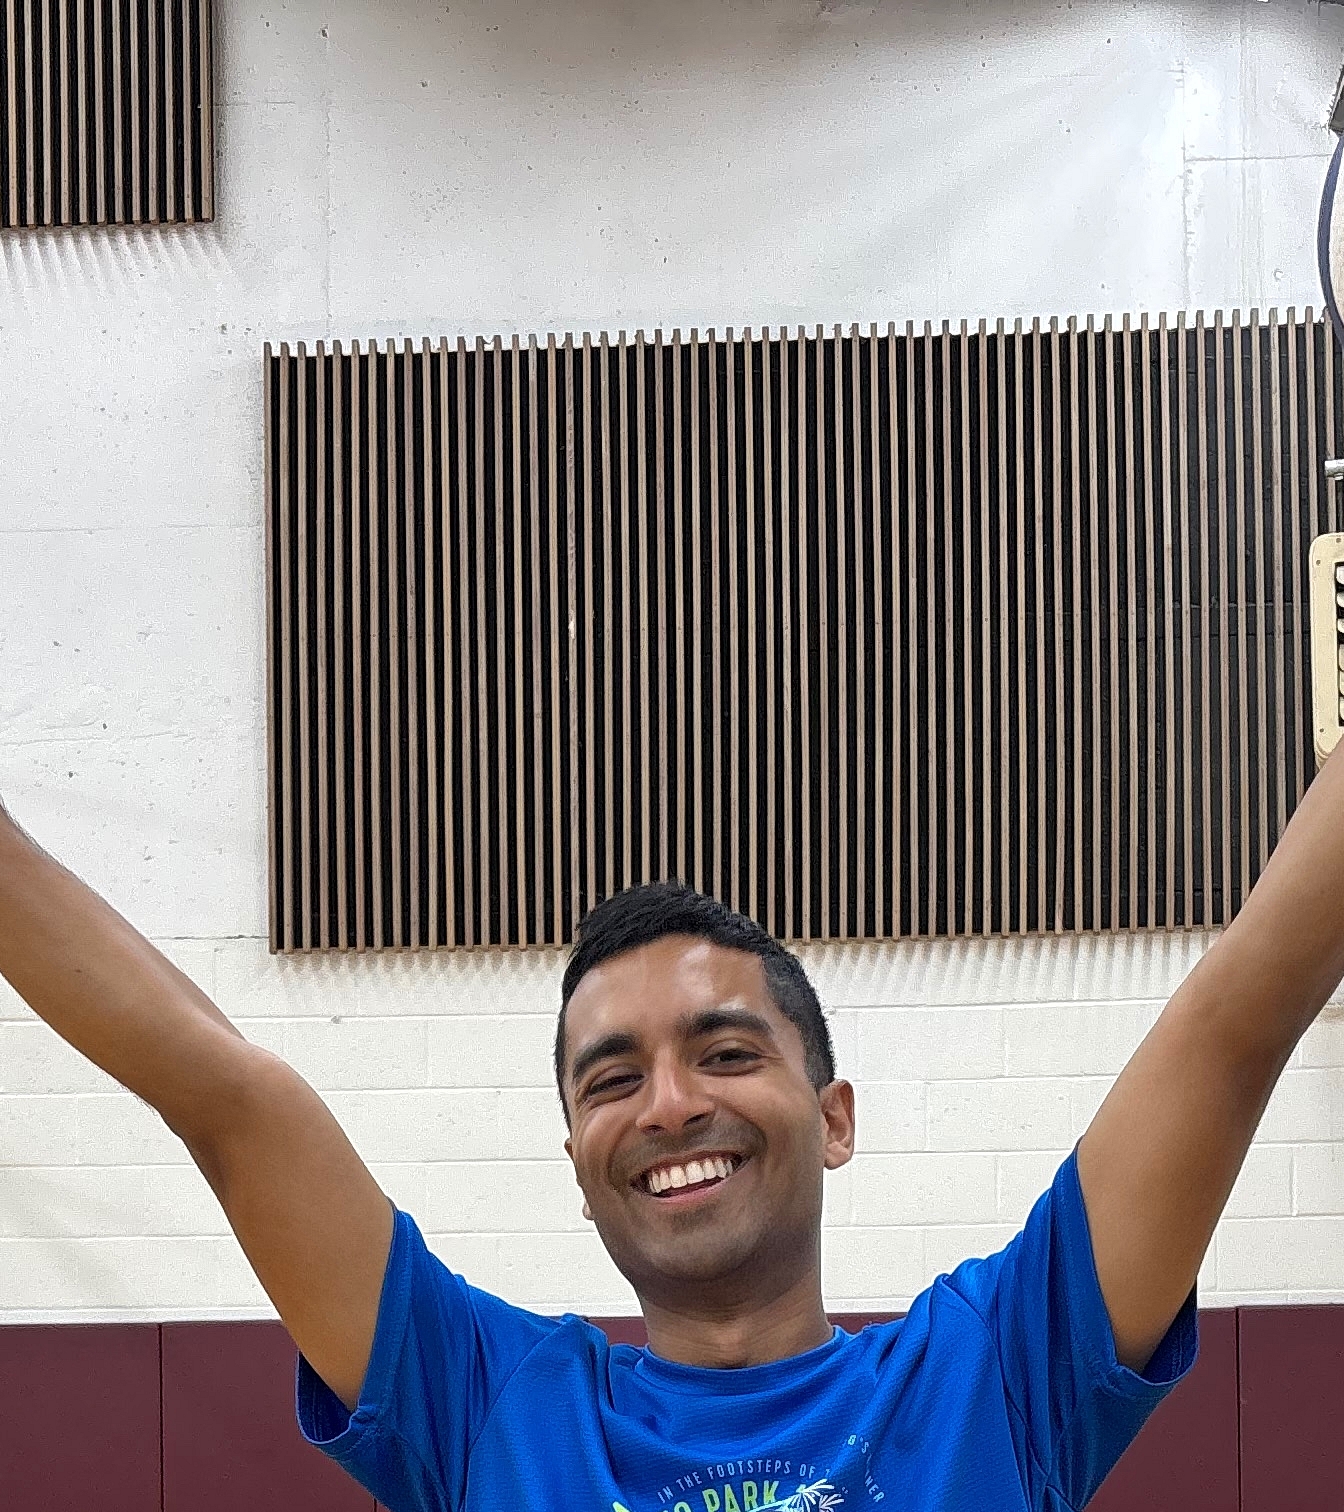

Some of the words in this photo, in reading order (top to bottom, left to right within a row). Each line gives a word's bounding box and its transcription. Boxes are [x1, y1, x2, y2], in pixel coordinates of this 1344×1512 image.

[658, 1485, 674, 1503] IN
[676, 1471, 702, 1491] THE
[707, 1459, 791, 1480] FOOTSTEPS
[799, 1463, 816, 1479] OF
